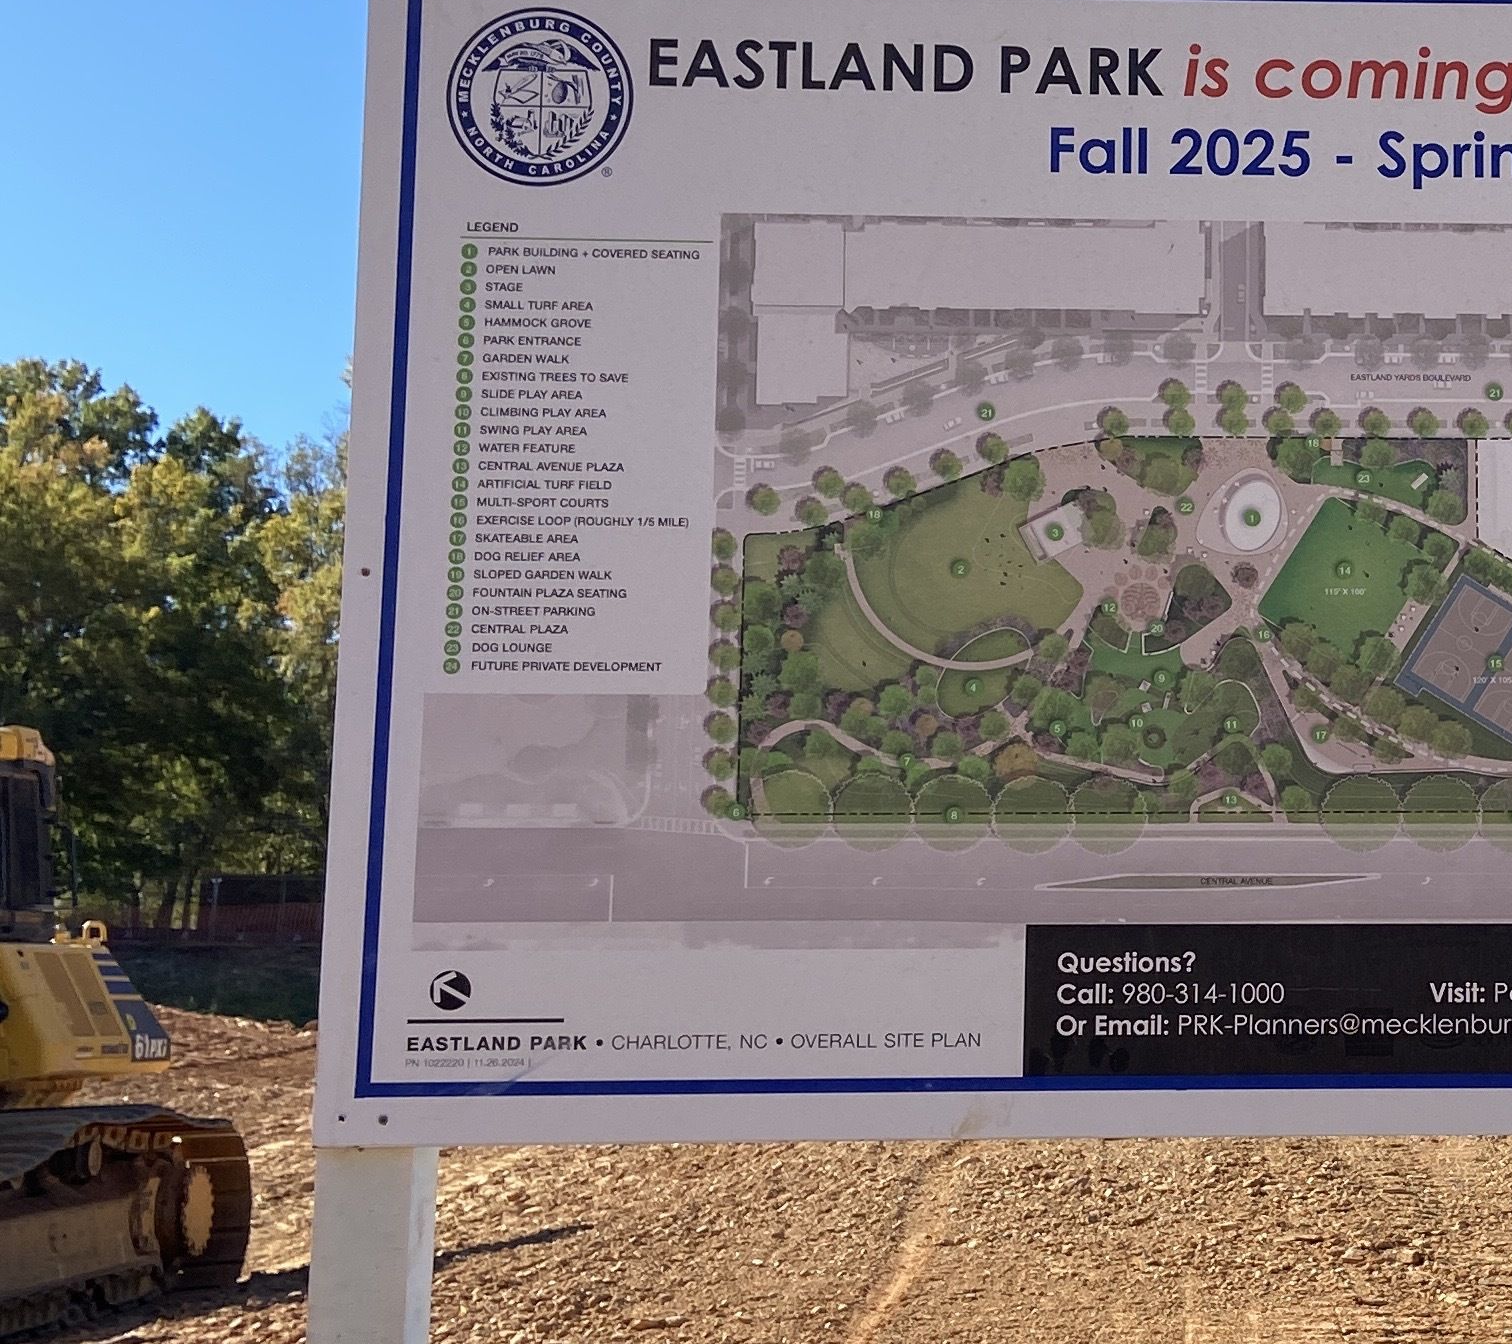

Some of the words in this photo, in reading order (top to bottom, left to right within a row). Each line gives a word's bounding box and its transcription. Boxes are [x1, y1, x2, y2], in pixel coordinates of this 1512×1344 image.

[458, 18, 570, 103] MECKLENBURG
[580, 33, 622, 106] COUNTY
[649, 39, 973, 91] EASTLAND
[1000, 46, 1163, 95] PARK
[1183, 43, 1229, 97] is
[467, 127, 514, 169] NORTH
[528, 131, 610, 175] CAROLINA
[1050, 127, 1147, 173] Fall
[1169, 128, 1310, 176] 2025
[466, 221, 518, 232] LEGEND
[485, 264, 518, 274] OPEN
[522, 265, 555, 274] LAWN
[478, 442, 519, 452] WATER
[522, 443, 575, 453] FEATURE
[471, 605, 540, 615] ON-STREET
[542, 606, 595, 616] PARKING
[471, 623, 525, 633] CENTRAL
[529, 624, 568, 634] PLAZA
[471, 642, 498, 652] DOG
[502, 642, 552, 652] LOUNGE
[471, 660, 518, 670] FUTURE
[521, 661, 570, 671] PRIVATE
[573, 661, 662, 671] DEVELOPMENT
[1057, 951, 1196, 973] Questions?
[1056, 983, 1113, 1004] Call:
[1122, 982, 1284, 1003] 980-314-1000
[1429, 982, 1485, 1002] Visit:
[1056, 1014, 1087, 1035] Or
[1095, 1014, 1169, 1035] Email:
[406, 1036, 520, 1051] EASTLAND
[530, 1035, 586, 1050] PARK
[611, 1034, 730, 1050] CHARLOTTE,
[740, 1034, 767, 1048] NC
[790, 1033, 876, 1048] OVERALL
[884, 1032, 923, 1048] SITE
[931, 1032, 980, 1047] PLAN
